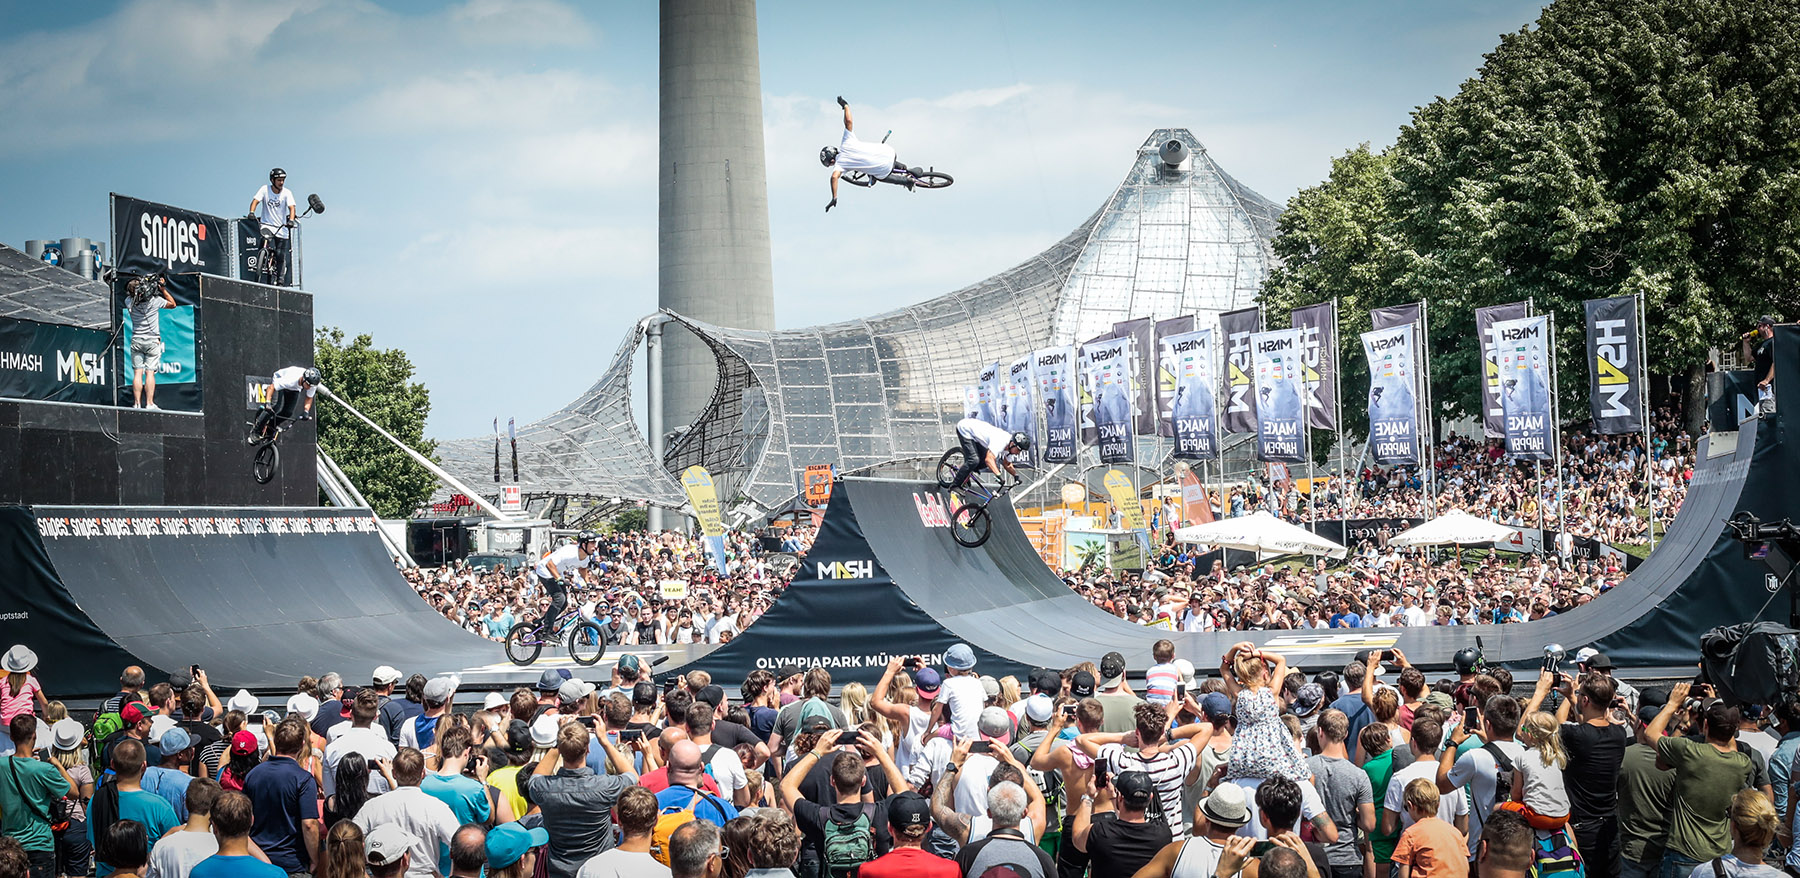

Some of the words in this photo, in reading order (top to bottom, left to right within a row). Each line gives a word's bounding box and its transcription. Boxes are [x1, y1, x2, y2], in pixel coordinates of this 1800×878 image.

[141, 212, 199, 270] snipes
[57, 350, 105, 385] MASH
[817, 560, 873, 579] MASH
